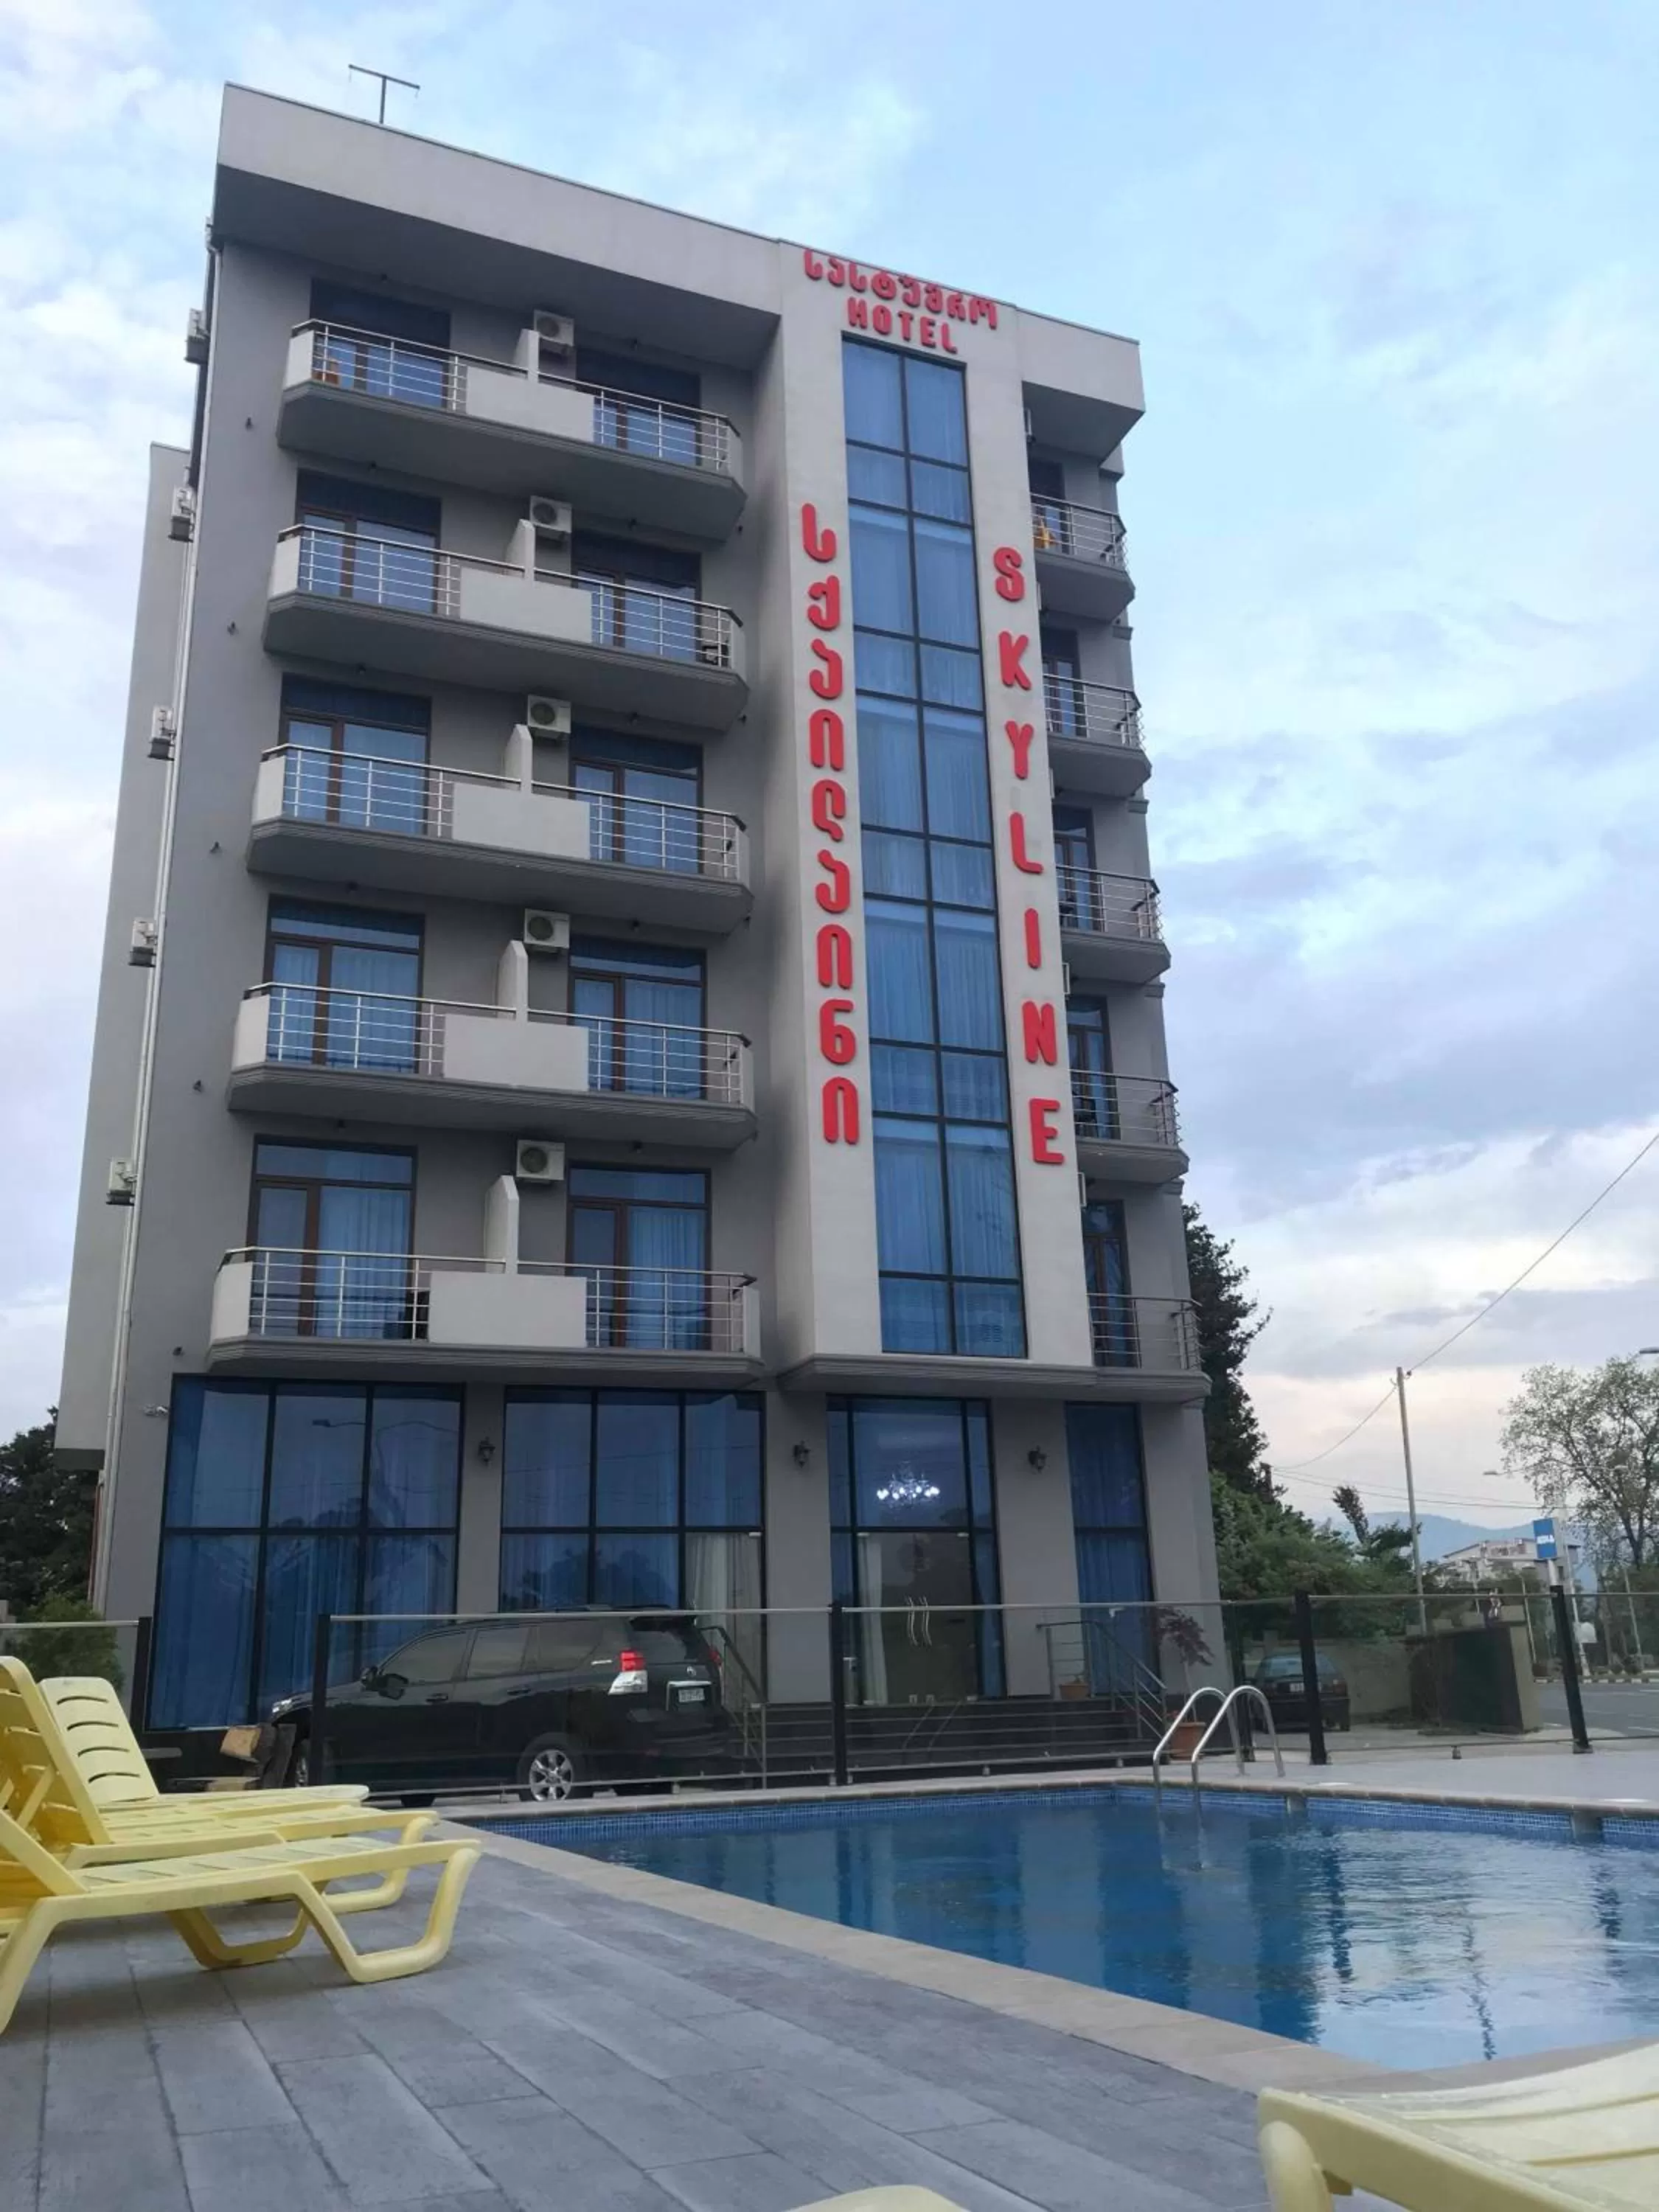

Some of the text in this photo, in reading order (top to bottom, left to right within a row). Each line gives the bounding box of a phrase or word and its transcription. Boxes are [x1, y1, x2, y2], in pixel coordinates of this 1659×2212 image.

[804, 248, 998, 330] სასტუმრო
[846, 296, 958, 355] HOTEL
[801, 503, 860, 1145] სკაილაინი
[993, 546, 1065, 1165] SKYLINE
